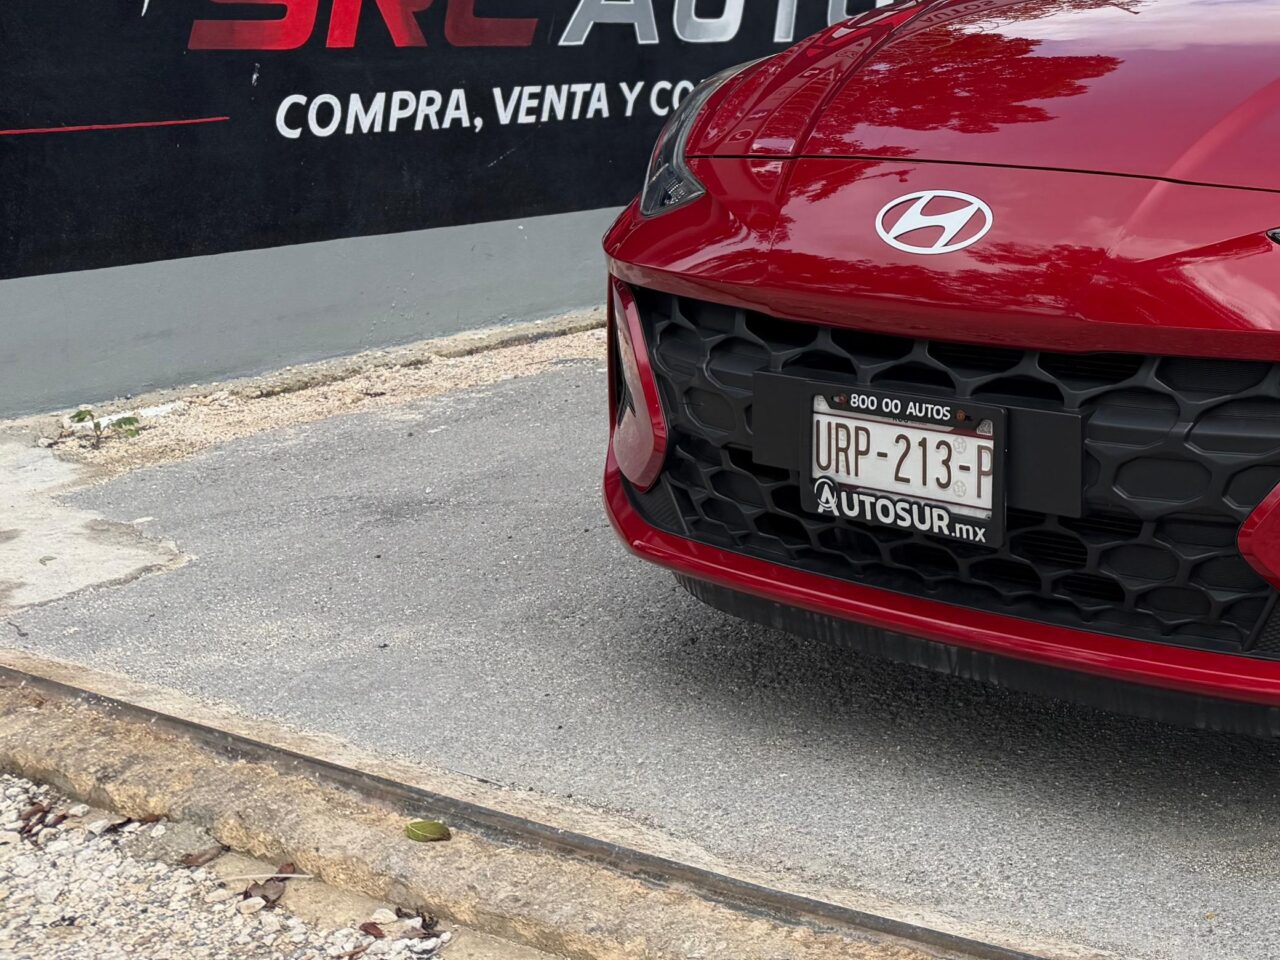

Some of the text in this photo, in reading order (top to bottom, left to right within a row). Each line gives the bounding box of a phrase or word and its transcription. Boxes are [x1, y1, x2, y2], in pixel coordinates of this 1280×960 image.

[275, 88, 483, 139] COMPRA,
[493, 83, 609, 126] VENTA
[619, 81, 645, 117] Y
[850, 393, 951, 421] 800 00 AUTOS
[815, 418, 994, 499] URP-213-P
